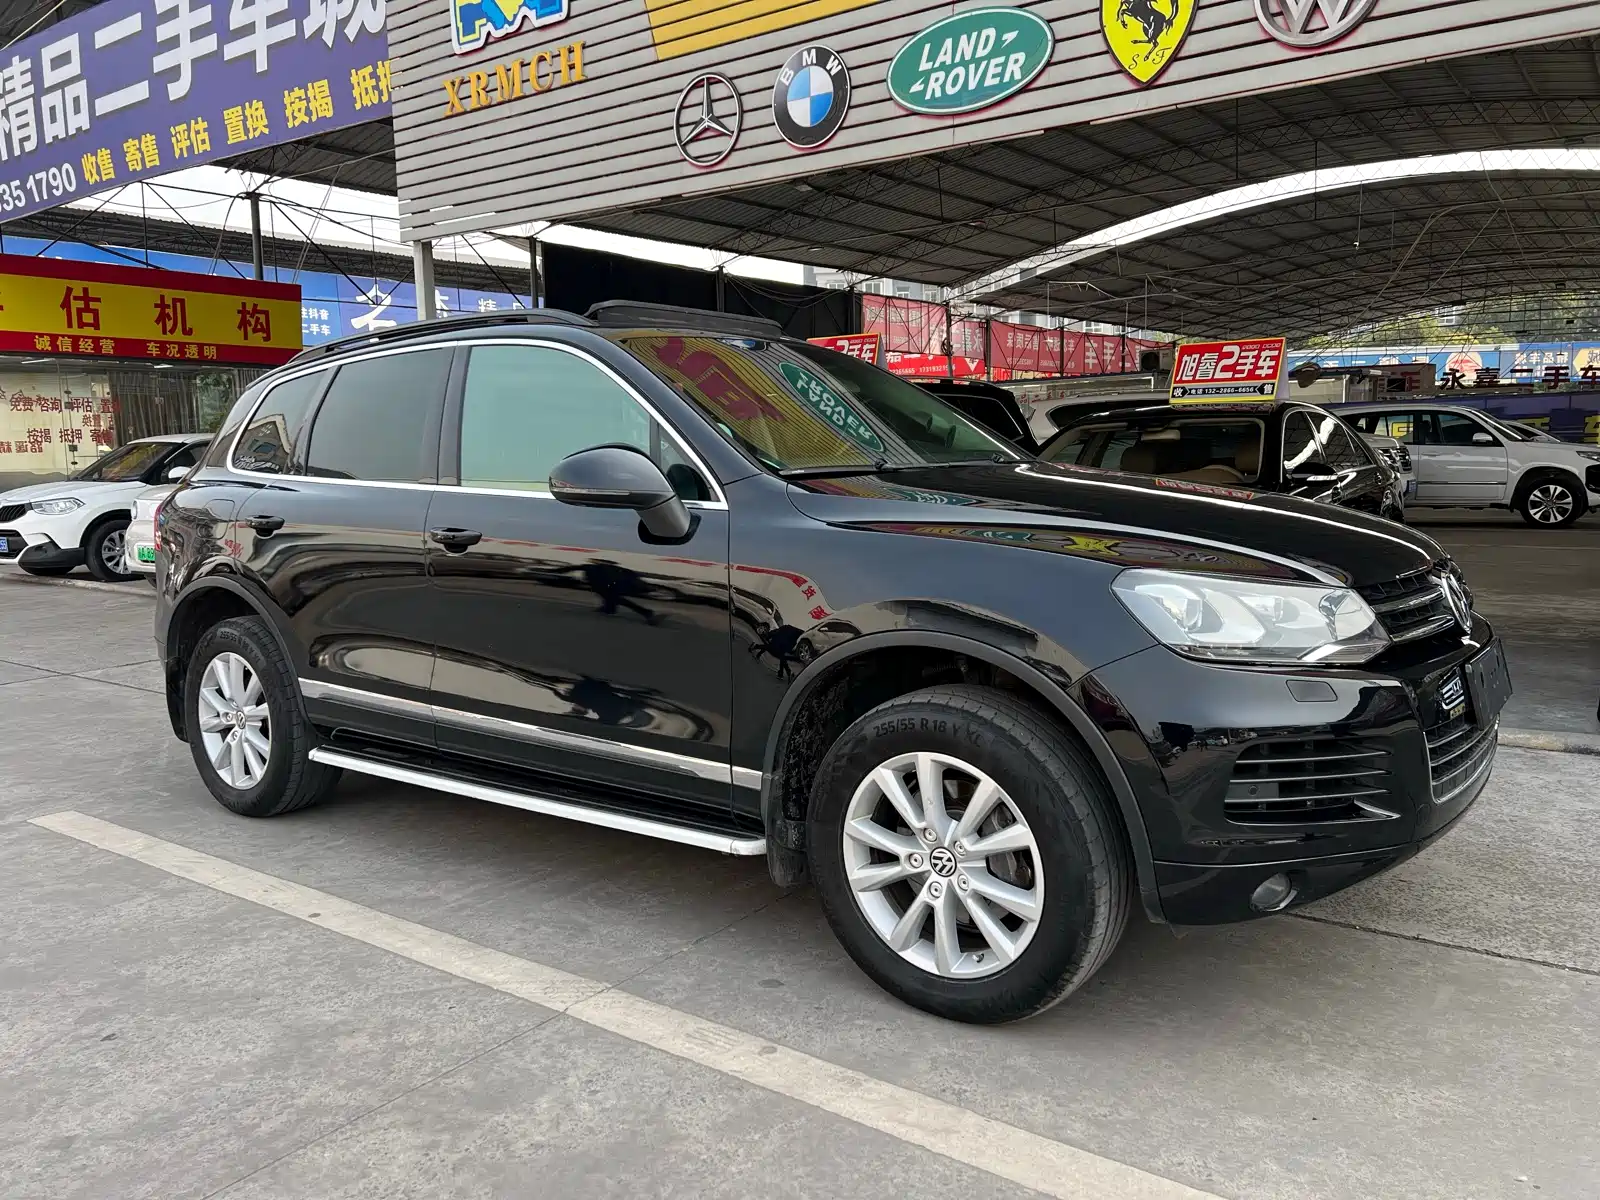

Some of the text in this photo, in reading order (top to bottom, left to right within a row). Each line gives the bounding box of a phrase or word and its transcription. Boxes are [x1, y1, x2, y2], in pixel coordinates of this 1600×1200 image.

[780, 48, 842, 86] BMW
[918, 27, 995, 71] LAND
[442, 41, 587, 117] XRMCH
[925, 51, 1026, 101] ROVER
[0, 162, 77, 213] 351790
[81, 148, 116, 185] 收售
[123, 133, 160, 173] 寄售
[170, 117, 211, 159] 评估
[223, 100, 269, 145] 置换
[283, 79, 333, 129] 按揭
[0, 286, 271, 342] 估机构
[301, 323, 331, 336] 二手车
[34, 335, 217, 359] 诚信经营 车况透明
[1176, 345, 1279, 381] 旭睿2手车
[10, 397, 33, 412] 免费
[1173, 388, 1183, 397] 收
[60, 428, 82, 443] 抵押
[873, 718, 915, 737] 255/55
[920, 718, 928, 730] R
[932, 720, 947, 733] 18
